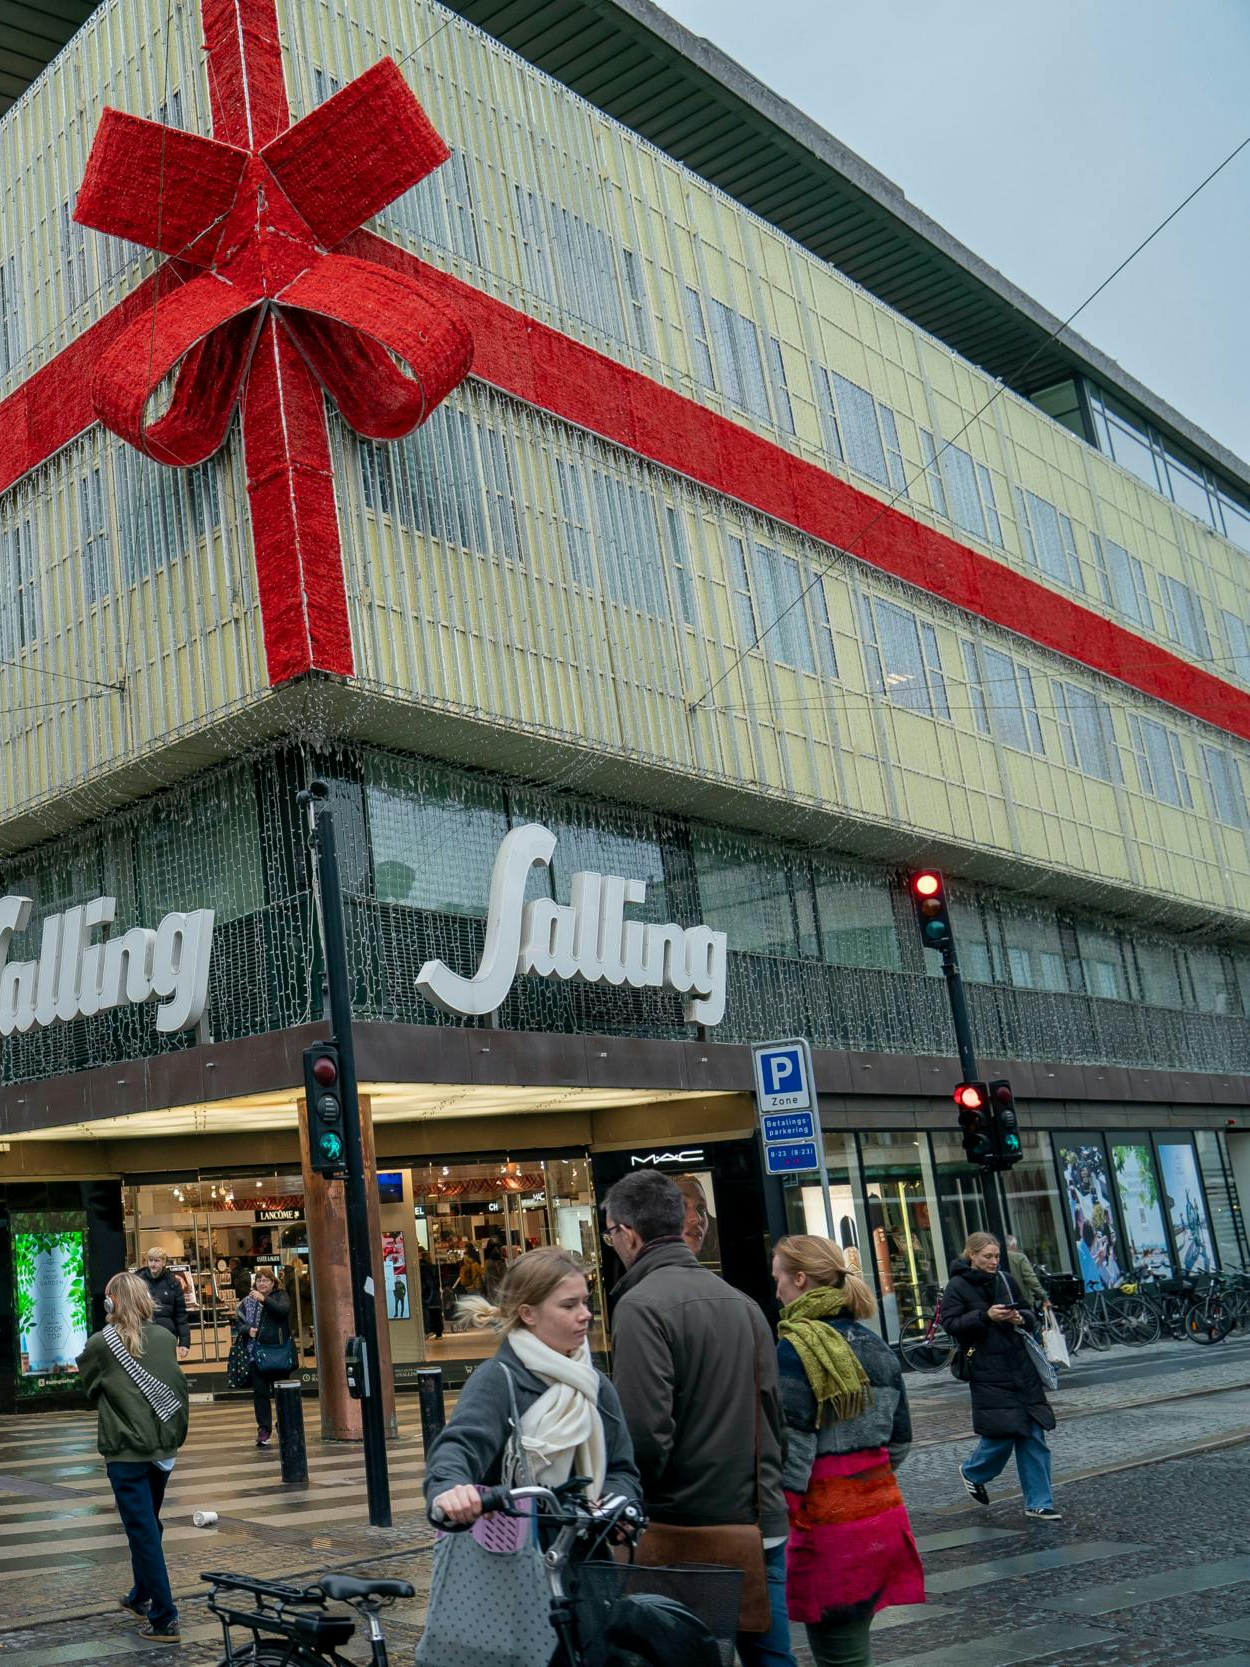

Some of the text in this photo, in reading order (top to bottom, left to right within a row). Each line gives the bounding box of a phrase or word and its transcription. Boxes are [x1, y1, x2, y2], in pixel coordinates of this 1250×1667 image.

[415, 823, 727, 1026] Salling
[770, 1056, 793, 1091] P
[771, 1096, 799, 1106] Zone
[769, 1126, 809, 1137] parkering
